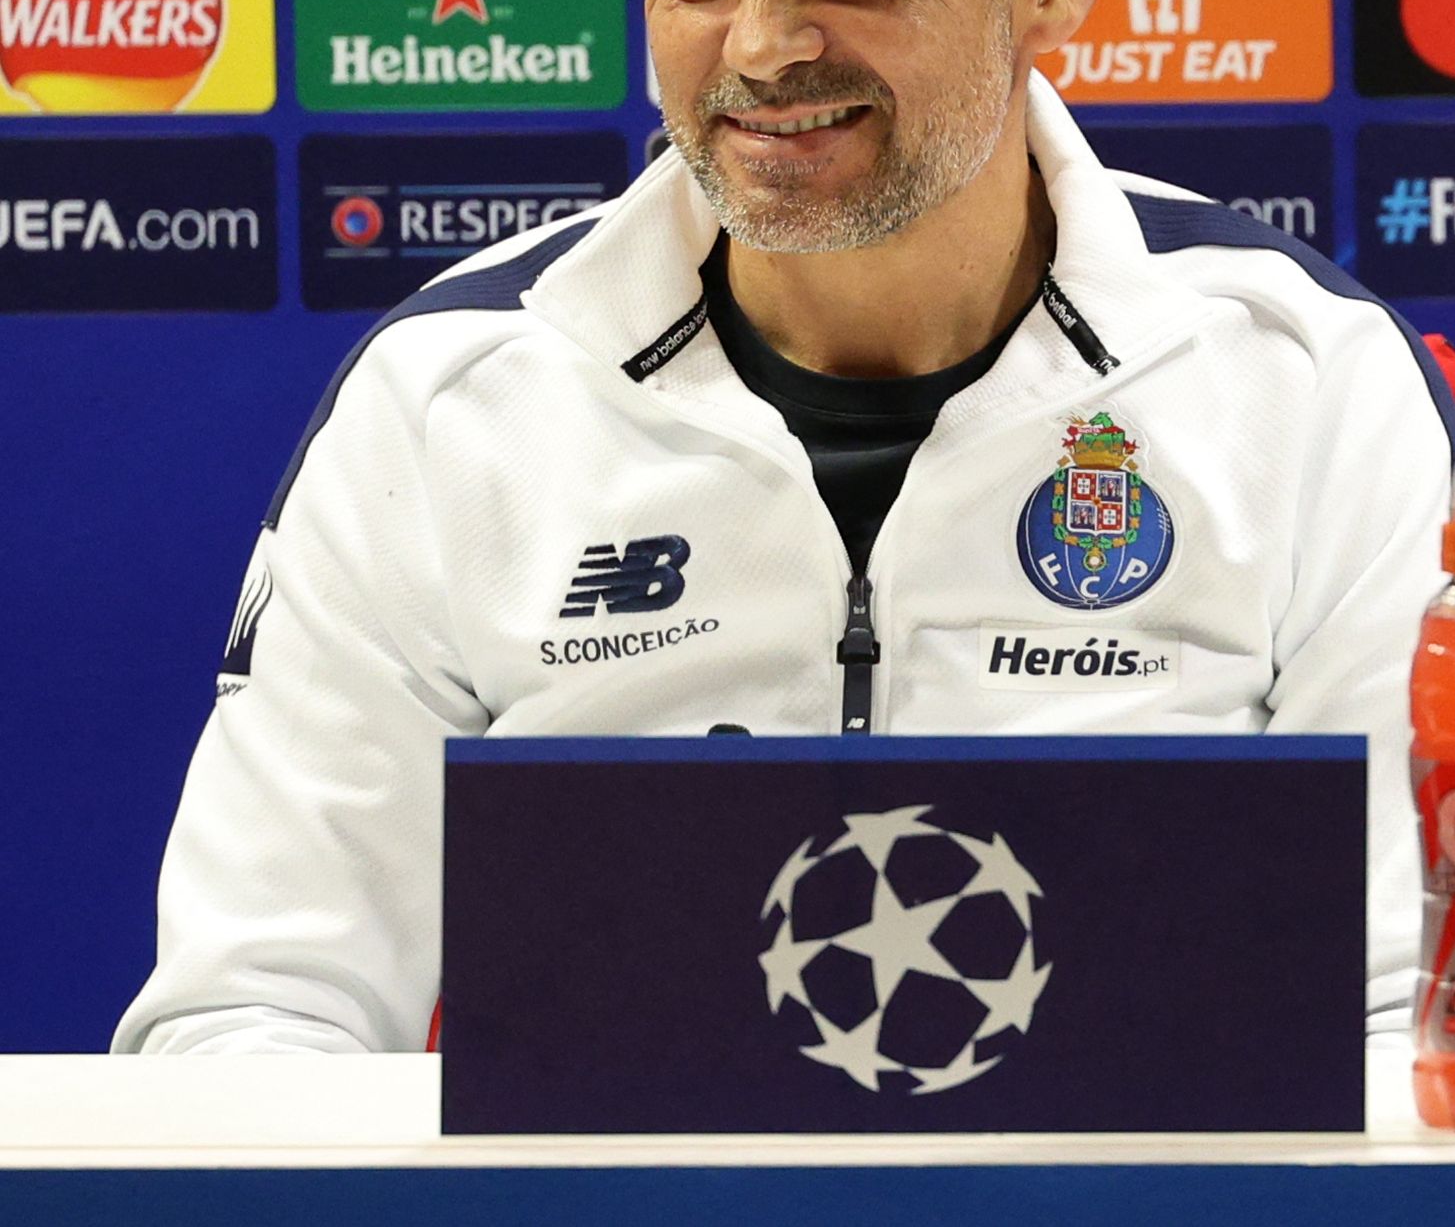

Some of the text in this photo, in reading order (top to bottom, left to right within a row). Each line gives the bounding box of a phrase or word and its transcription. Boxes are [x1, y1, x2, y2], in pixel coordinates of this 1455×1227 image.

[331, 34, 592, 84] Heineken
[1053, 40, 1277, 90] JUST EAT
[0, 199, 259, 250] EFA.com
[400, 198, 602, 242] RESPE
[540, 613, 720, 666] S.CONCEIÇÃO
[988, 636, 1168, 677] Heróis.pt
